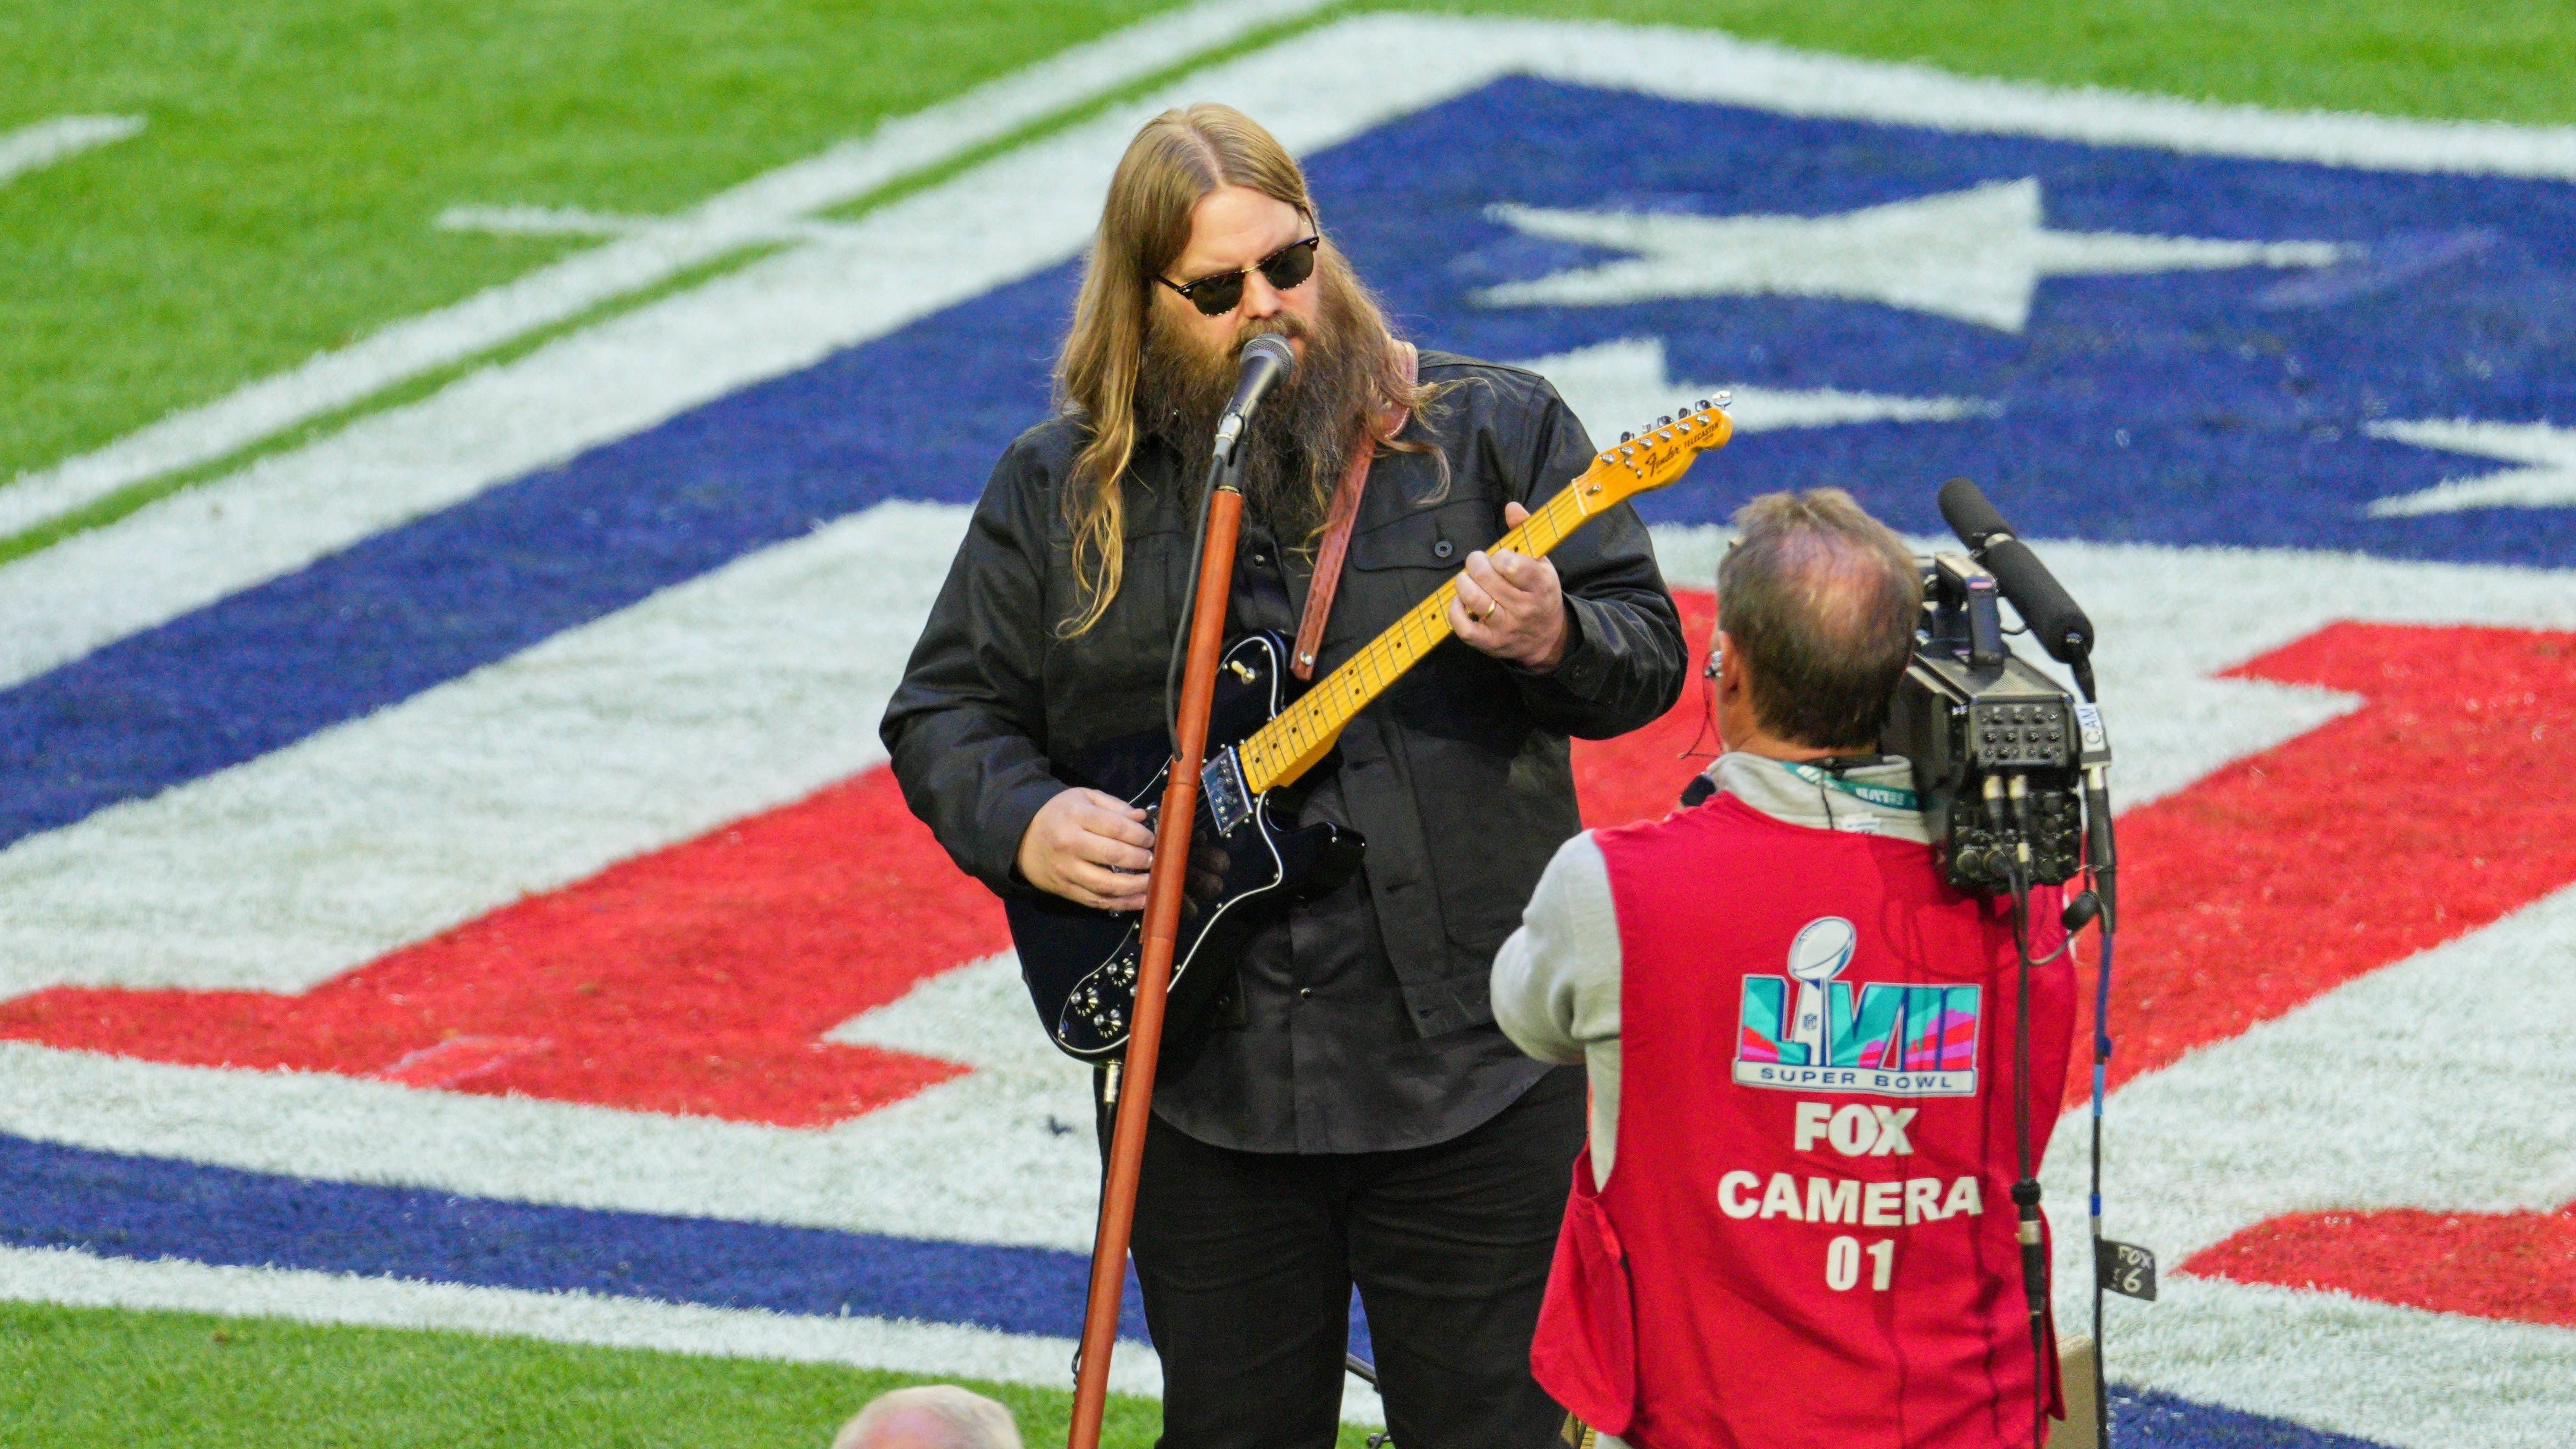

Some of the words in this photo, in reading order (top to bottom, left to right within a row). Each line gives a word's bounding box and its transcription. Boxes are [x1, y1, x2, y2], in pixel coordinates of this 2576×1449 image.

[1683, 421, 1719, 448] TELECASTER
[1645, 445, 1679, 477] Fender
[2078, 708, 2101, 744] CAM
[1761, 1067, 1855, 1085] SUPER
[1874, 1075, 1953, 1089] BOWL
[1794, 1101, 1918, 1156] FOX
[1718, 1171, 1983, 1227] CAMERA
[1826, 1236, 1894, 1291] 01
